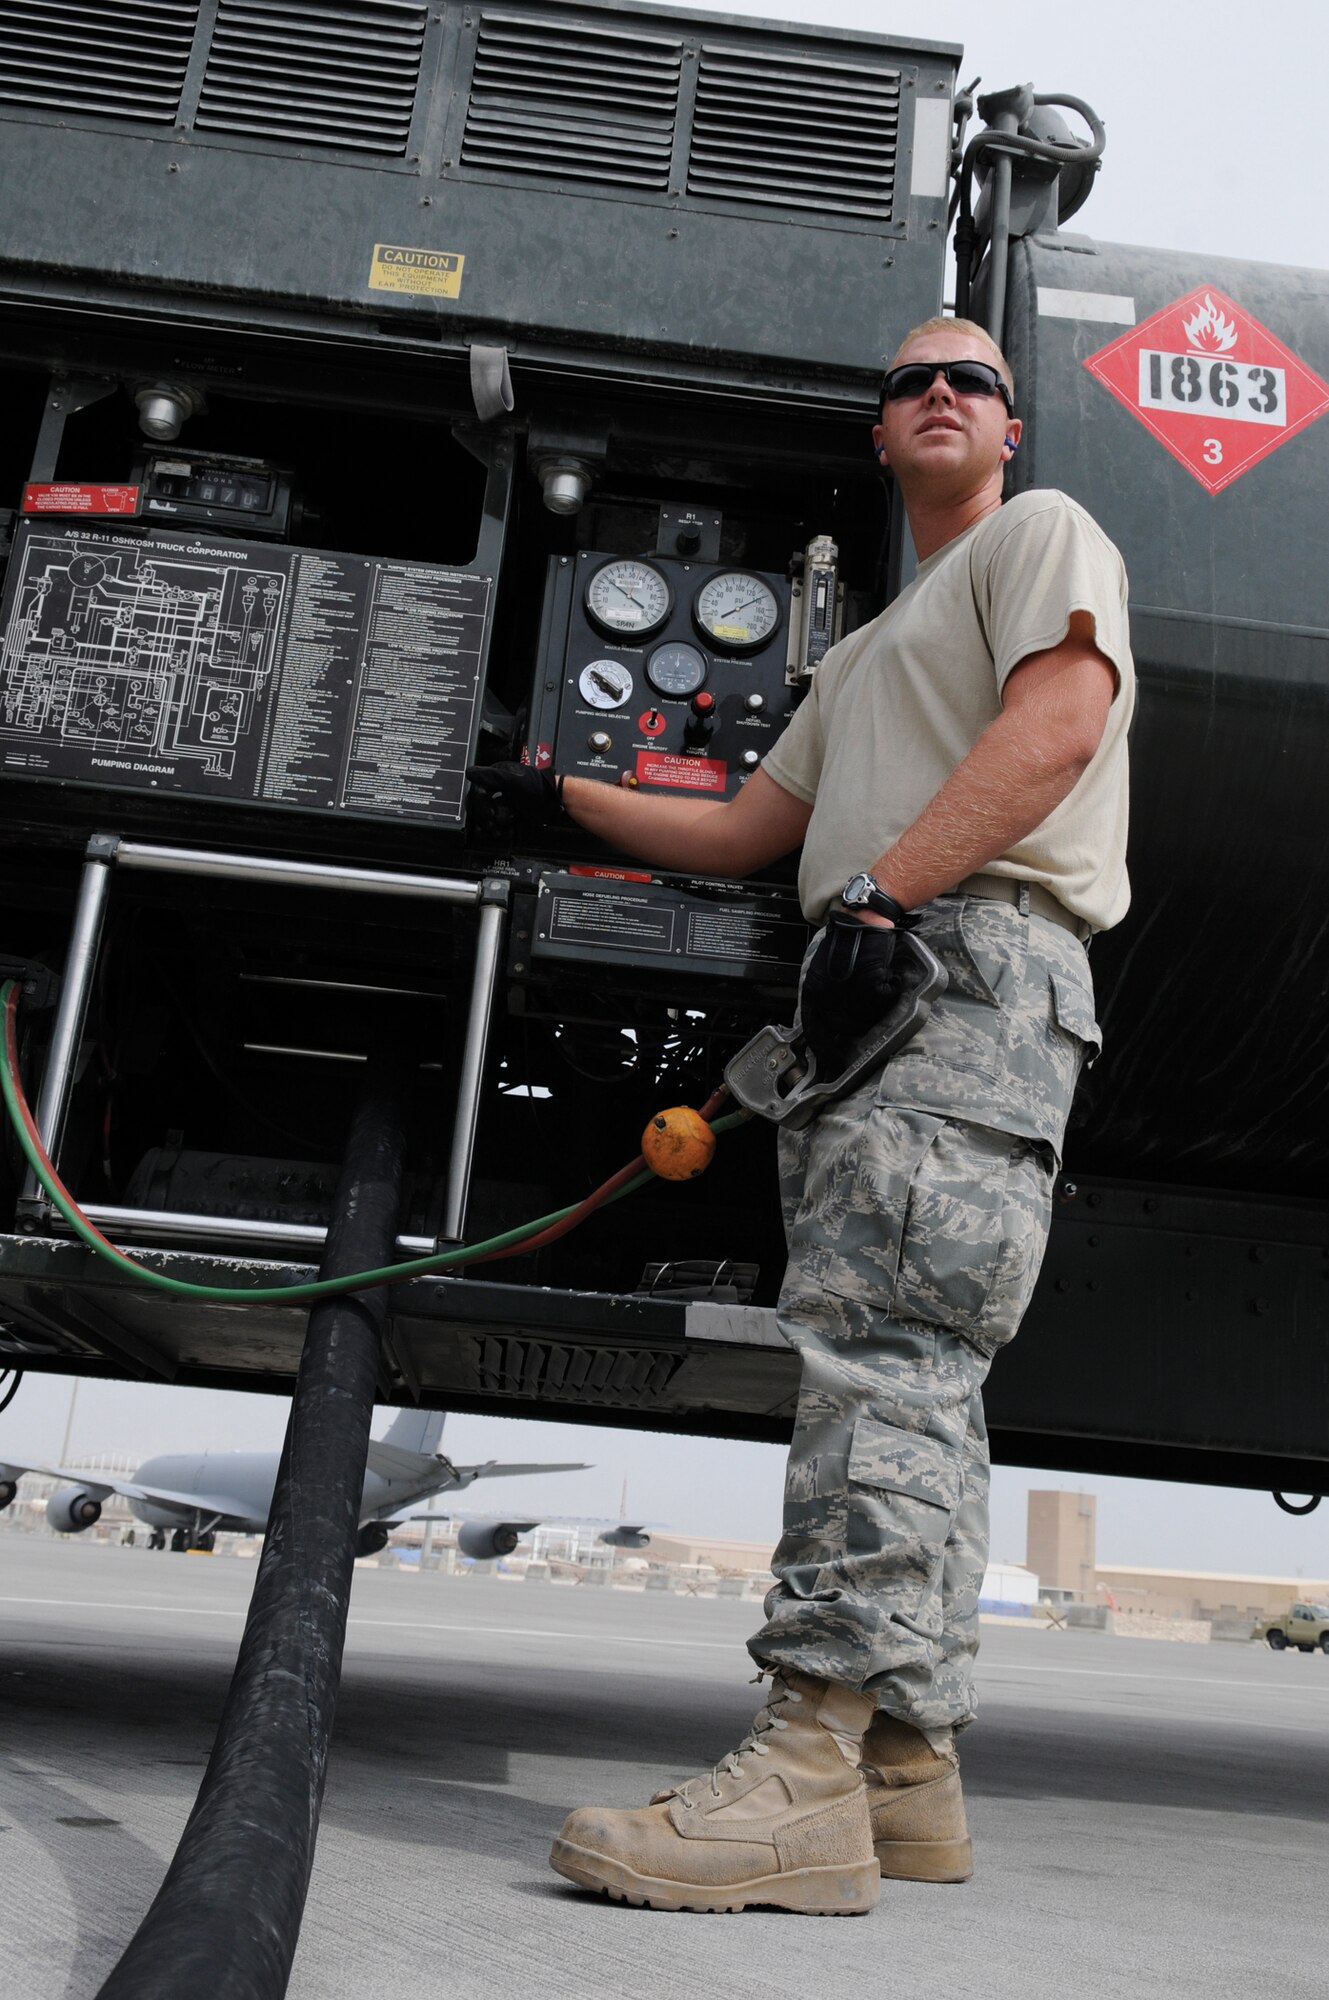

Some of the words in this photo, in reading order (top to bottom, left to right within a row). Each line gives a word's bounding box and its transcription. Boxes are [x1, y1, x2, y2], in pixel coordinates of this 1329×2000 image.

[384, 250, 449, 268] CAUTION
[402, 272, 448, 283] EQUIPMENT
[414, 268, 450, 277] OPERATE
[397, 278, 432, 286] WITHOUT
[399, 284, 449, 294] PROTECTION
[1150, 354, 1278, 414] 1863
[1203, 438, 1223, 464] 3
[686, 512, 696, 520] R1
[64, 530, 79, 538] A/S
[80, 532, 90, 540] 32
[92, 533, 110, 542] R-11
[111, 535, 154, 548] OSHKOSH
[156, 541, 185, 552] TRUCK
[186, 545, 248, 560] CORPORATION
[615, 620, 635, 628] SPAN
[91, 758, 131, 770] PUMPING
[133, 763, 175, 774] DIAGRAM
[664, 756, 701, 767] CAUTION
[594, 871, 625, 880] CAUTION
[620, 896, 648, 904] PROCEDURE
